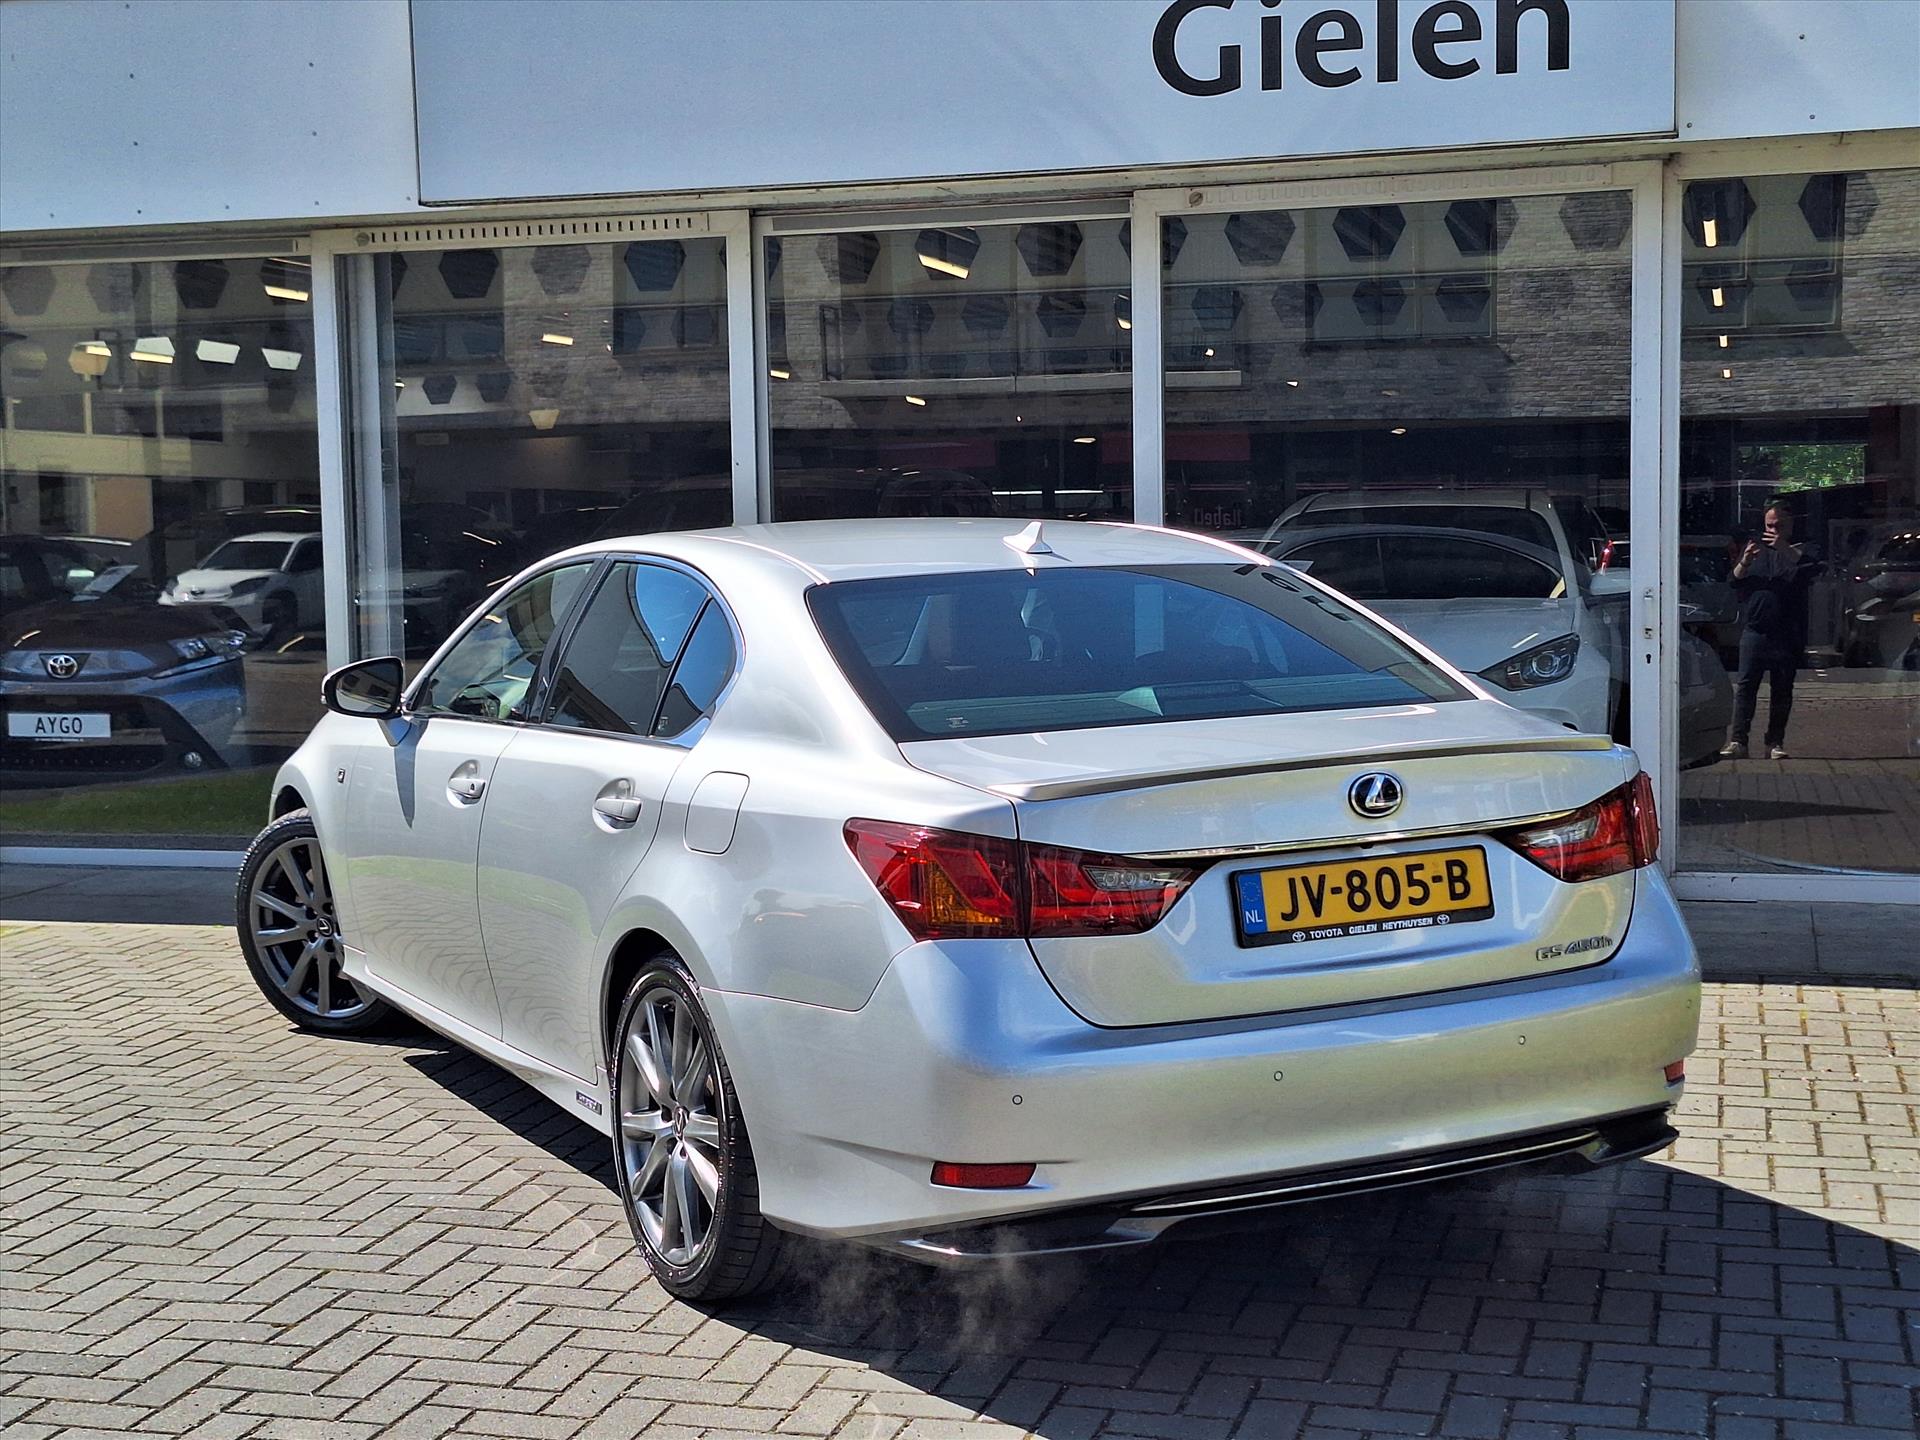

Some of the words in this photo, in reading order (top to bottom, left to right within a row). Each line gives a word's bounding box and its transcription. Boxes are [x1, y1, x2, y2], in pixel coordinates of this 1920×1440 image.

[1152, 0, 1571, 97] Gielen
[34, 716, 84, 735] AYGO
[1280, 858, 1471, 922] JV-805-B
[1245, 909, 1264, 925] NL
[1309, 927, 1344, 940] TOYOTA
[1348, 923, 1378, 935] GIELEN
[1382, 917, 1434, 931] HEYTHUYSEN
[1536, 944, 1563, 962] GS
